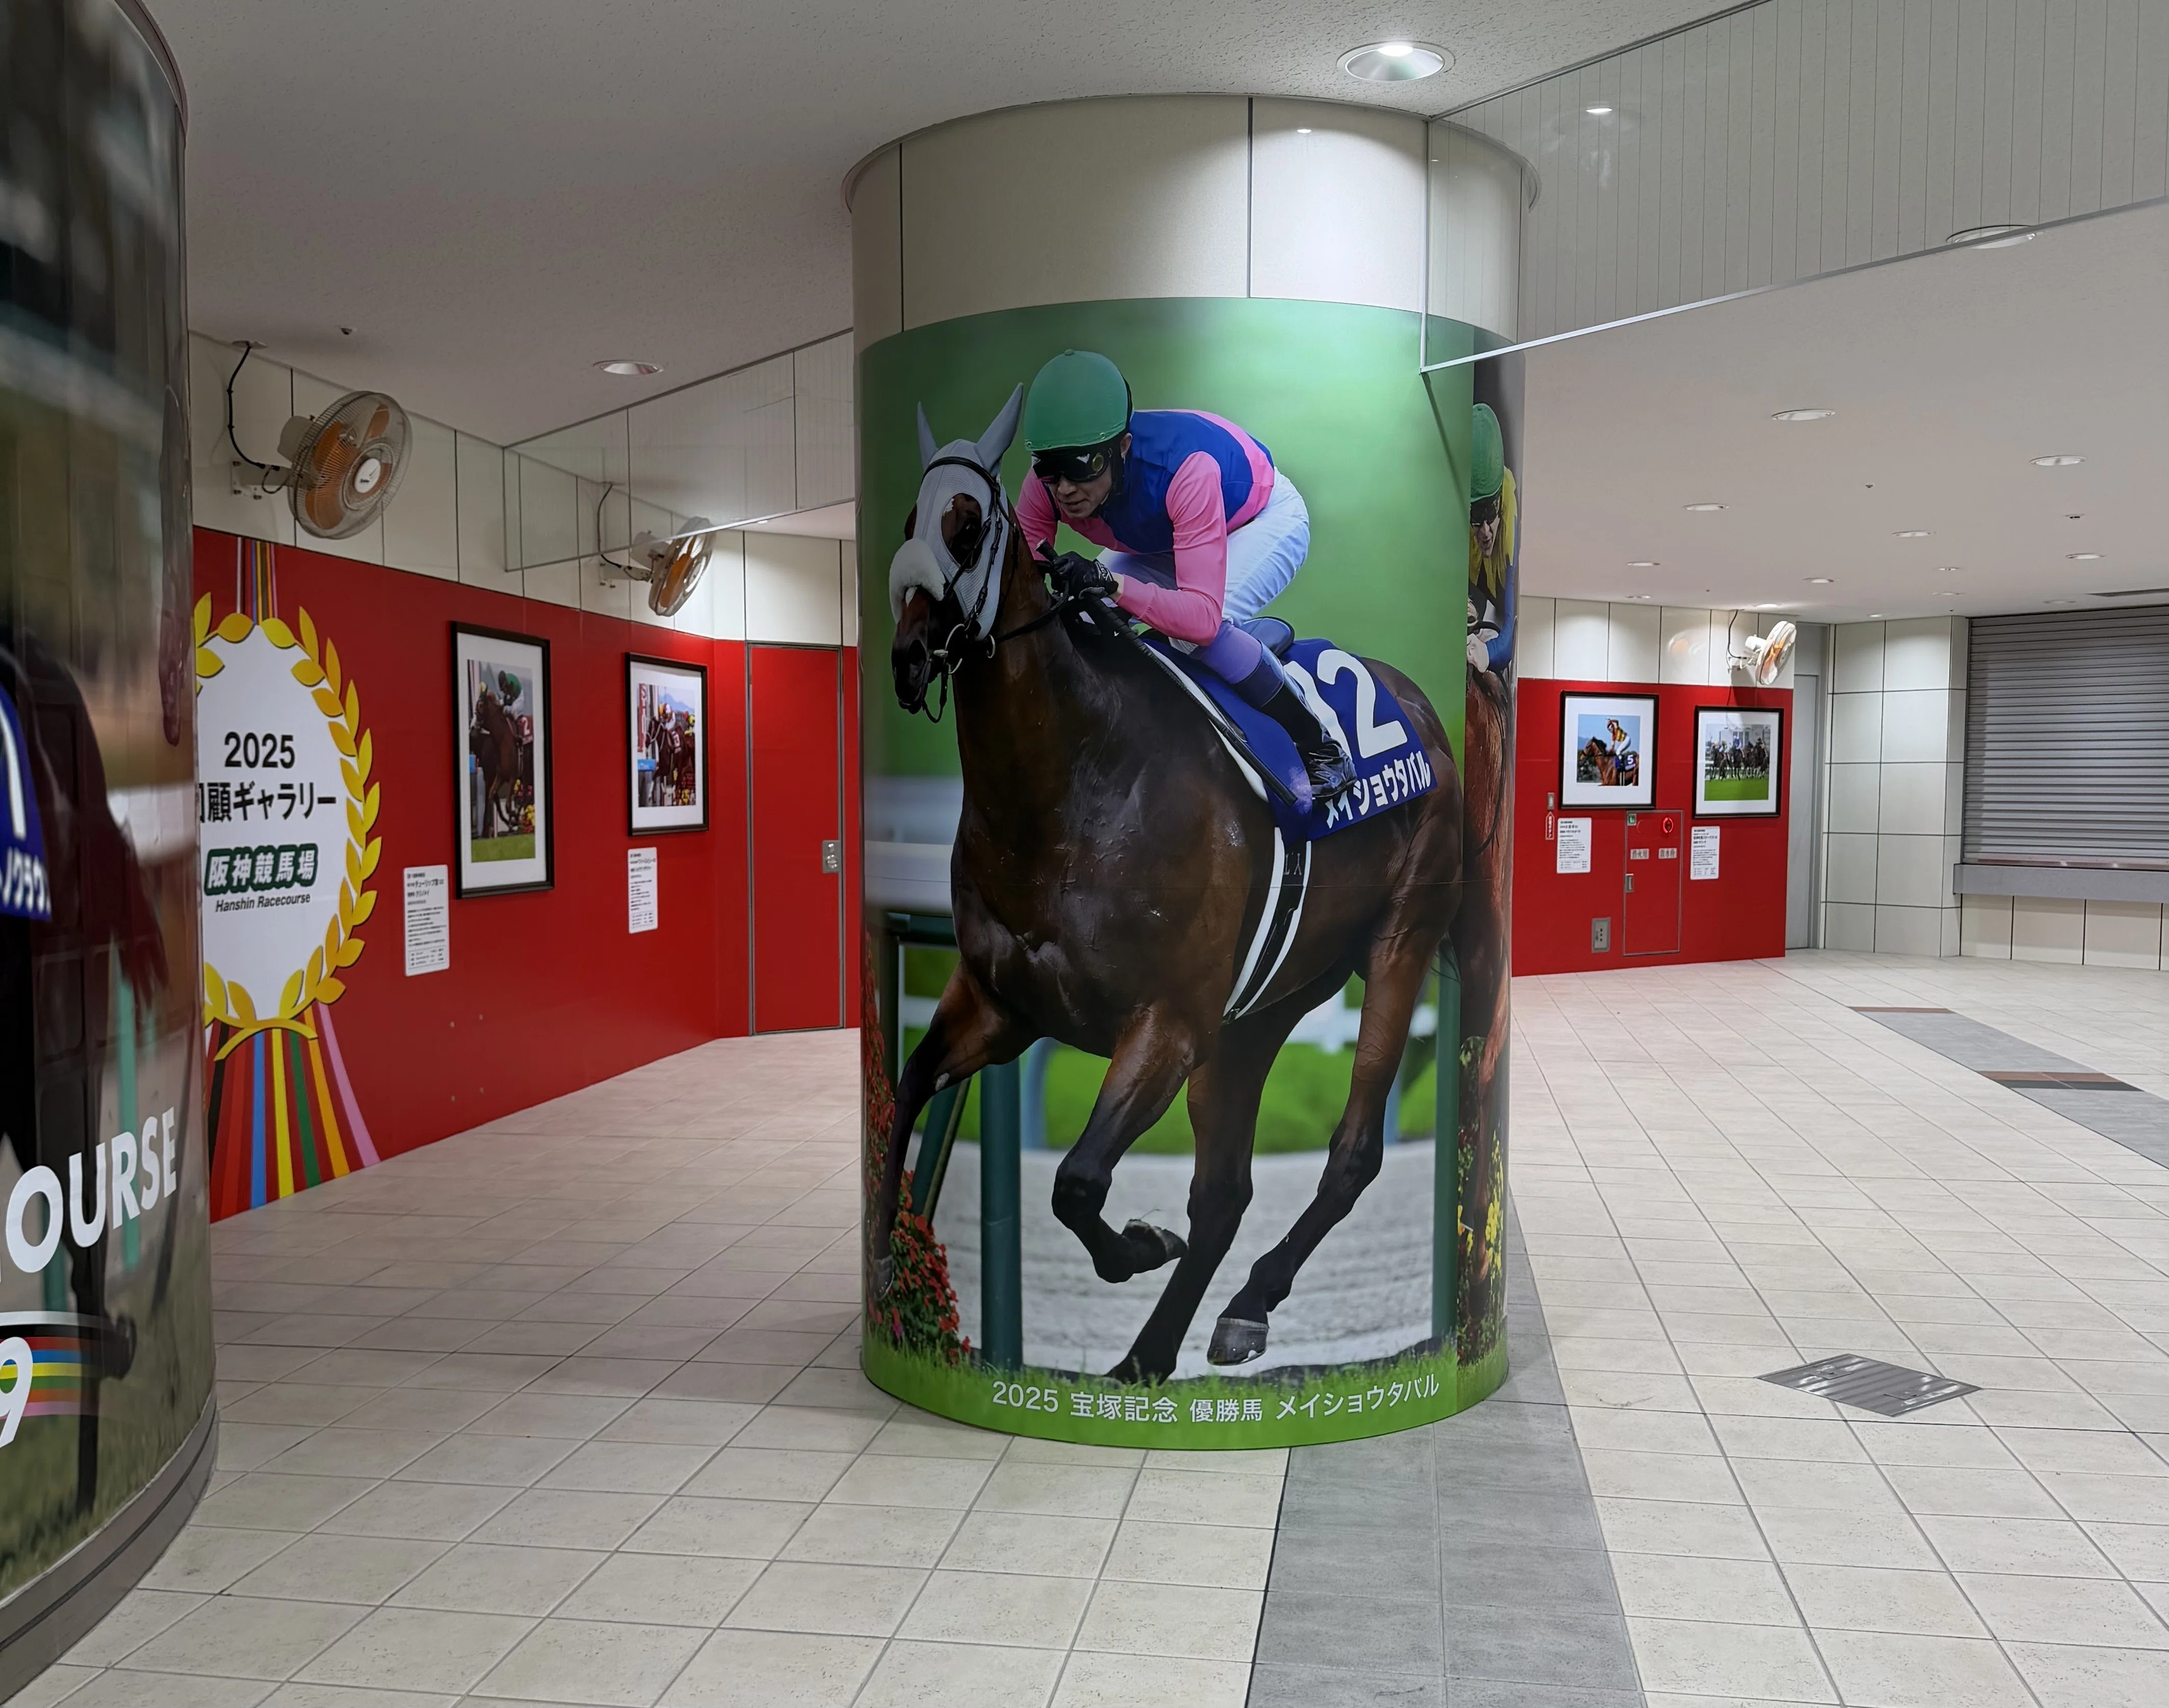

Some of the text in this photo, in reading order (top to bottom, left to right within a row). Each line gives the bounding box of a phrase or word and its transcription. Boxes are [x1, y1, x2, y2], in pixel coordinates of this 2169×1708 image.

[224, 731, 295, 769] 2025
[1627, 754, 1634, 765] 5
[199, 781, 336, 823] 顧ギャラリー
[1325, 750, 1431, 829] メイショウタバル
[207, 850, 315, 889] 阪神競馬場
[215, 892, 311, 912] Hanshin Racecourse
[0, 1106, 177, 1273] OURSE
[993, 1373, 1440, 1422] 2025 宝塚記念 優勝馬 メイショウタバル
